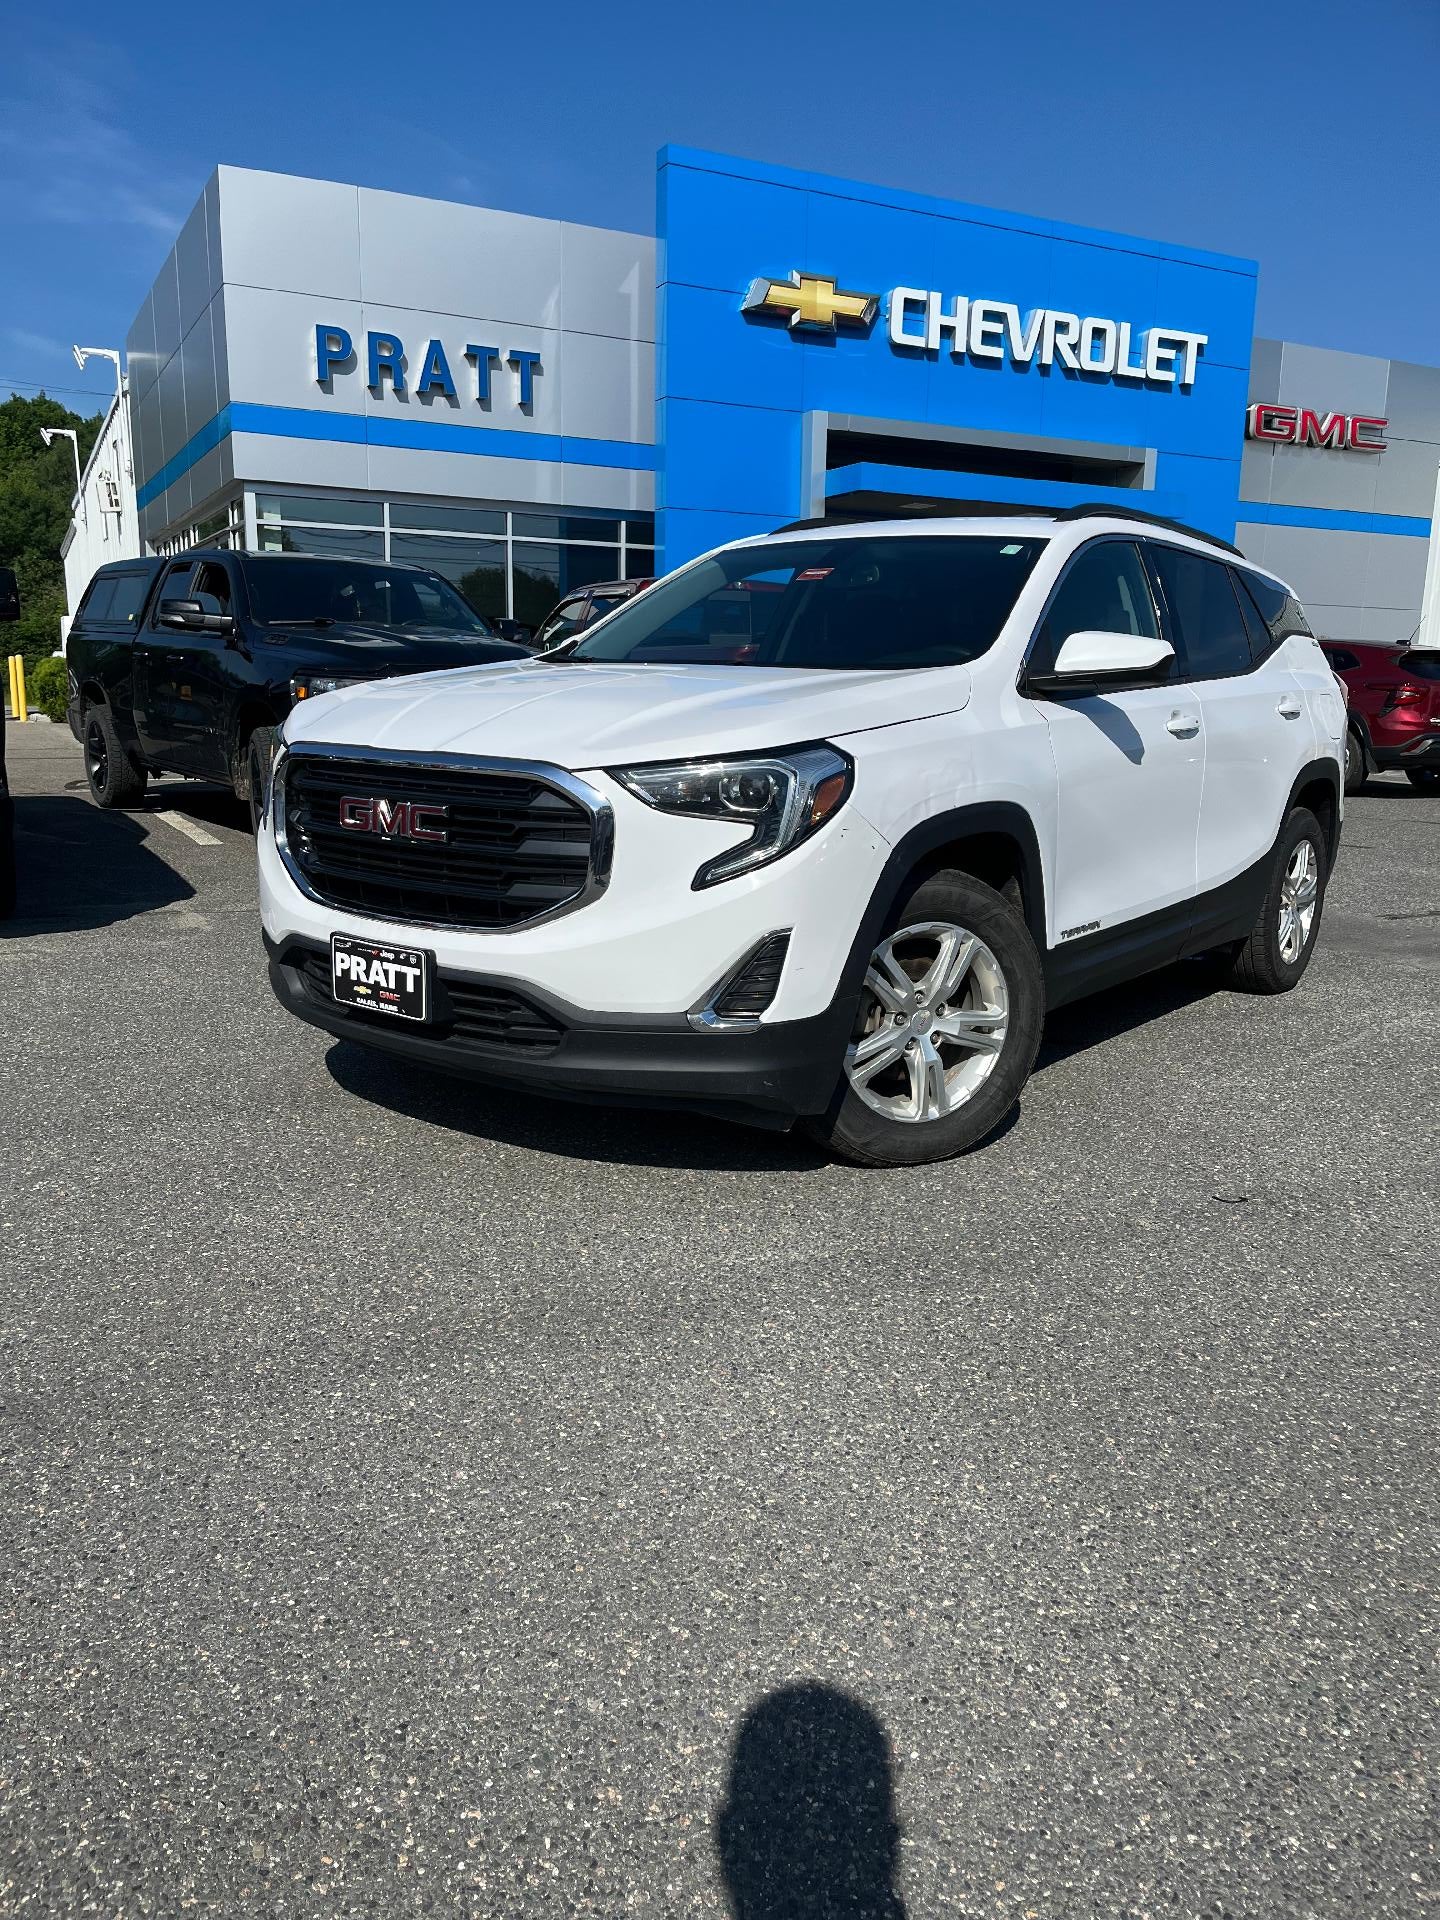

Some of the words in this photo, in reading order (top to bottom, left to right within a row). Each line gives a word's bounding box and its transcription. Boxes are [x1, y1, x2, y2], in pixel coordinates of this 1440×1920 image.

[888, 286, 1209, 386] CHEVROLET
[314, 323, 542, 406] PRATT
[1247, 402, 1389, 451] GMC
[340, 796, 449, 842] GMC
[335, 951, 421, 993] PRATT
[380, 949, 395, 961] Jeep
[379, 990, 401, 1002] GMC
